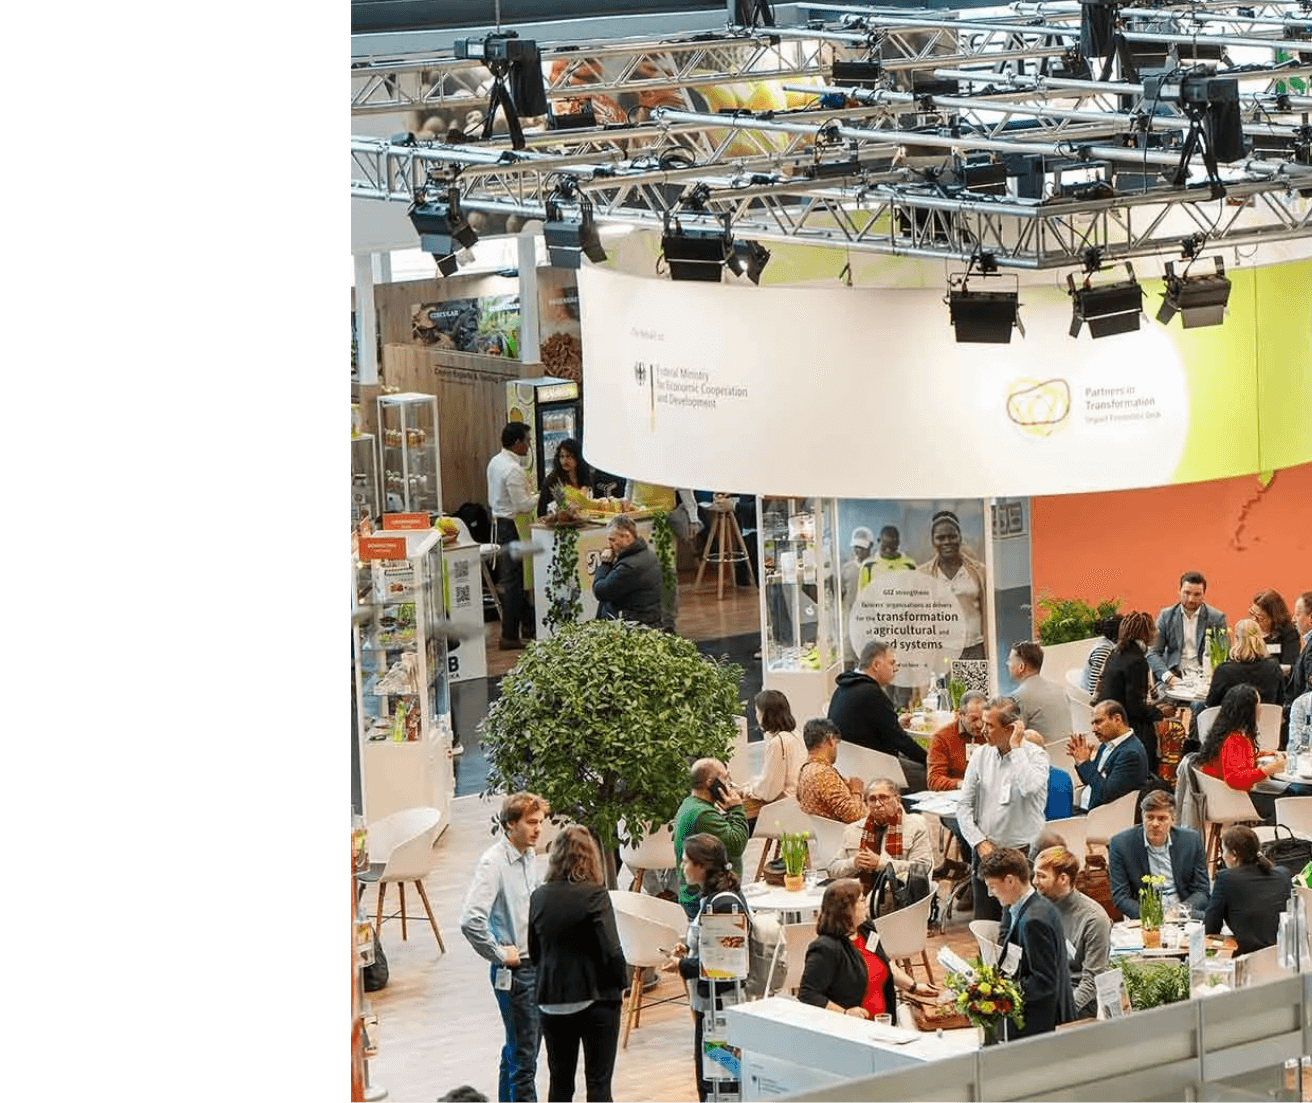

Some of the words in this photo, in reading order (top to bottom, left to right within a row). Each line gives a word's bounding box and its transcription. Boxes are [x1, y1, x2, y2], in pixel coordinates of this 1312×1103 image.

[680, 367, 709, 383] Ministry
[701, 383, 748, 398] Cooperation
[1084, 387, 1125, 398] Partners
[1126, 386, 1136, 394] in
[669, 394, 716, 409] Development
[1085, 397, 1156, 410] Transformation
[876, 611, 959, 623] transformation
[873, 625, 936, 637] agricultural
[900, 640, 943, 651] systems
